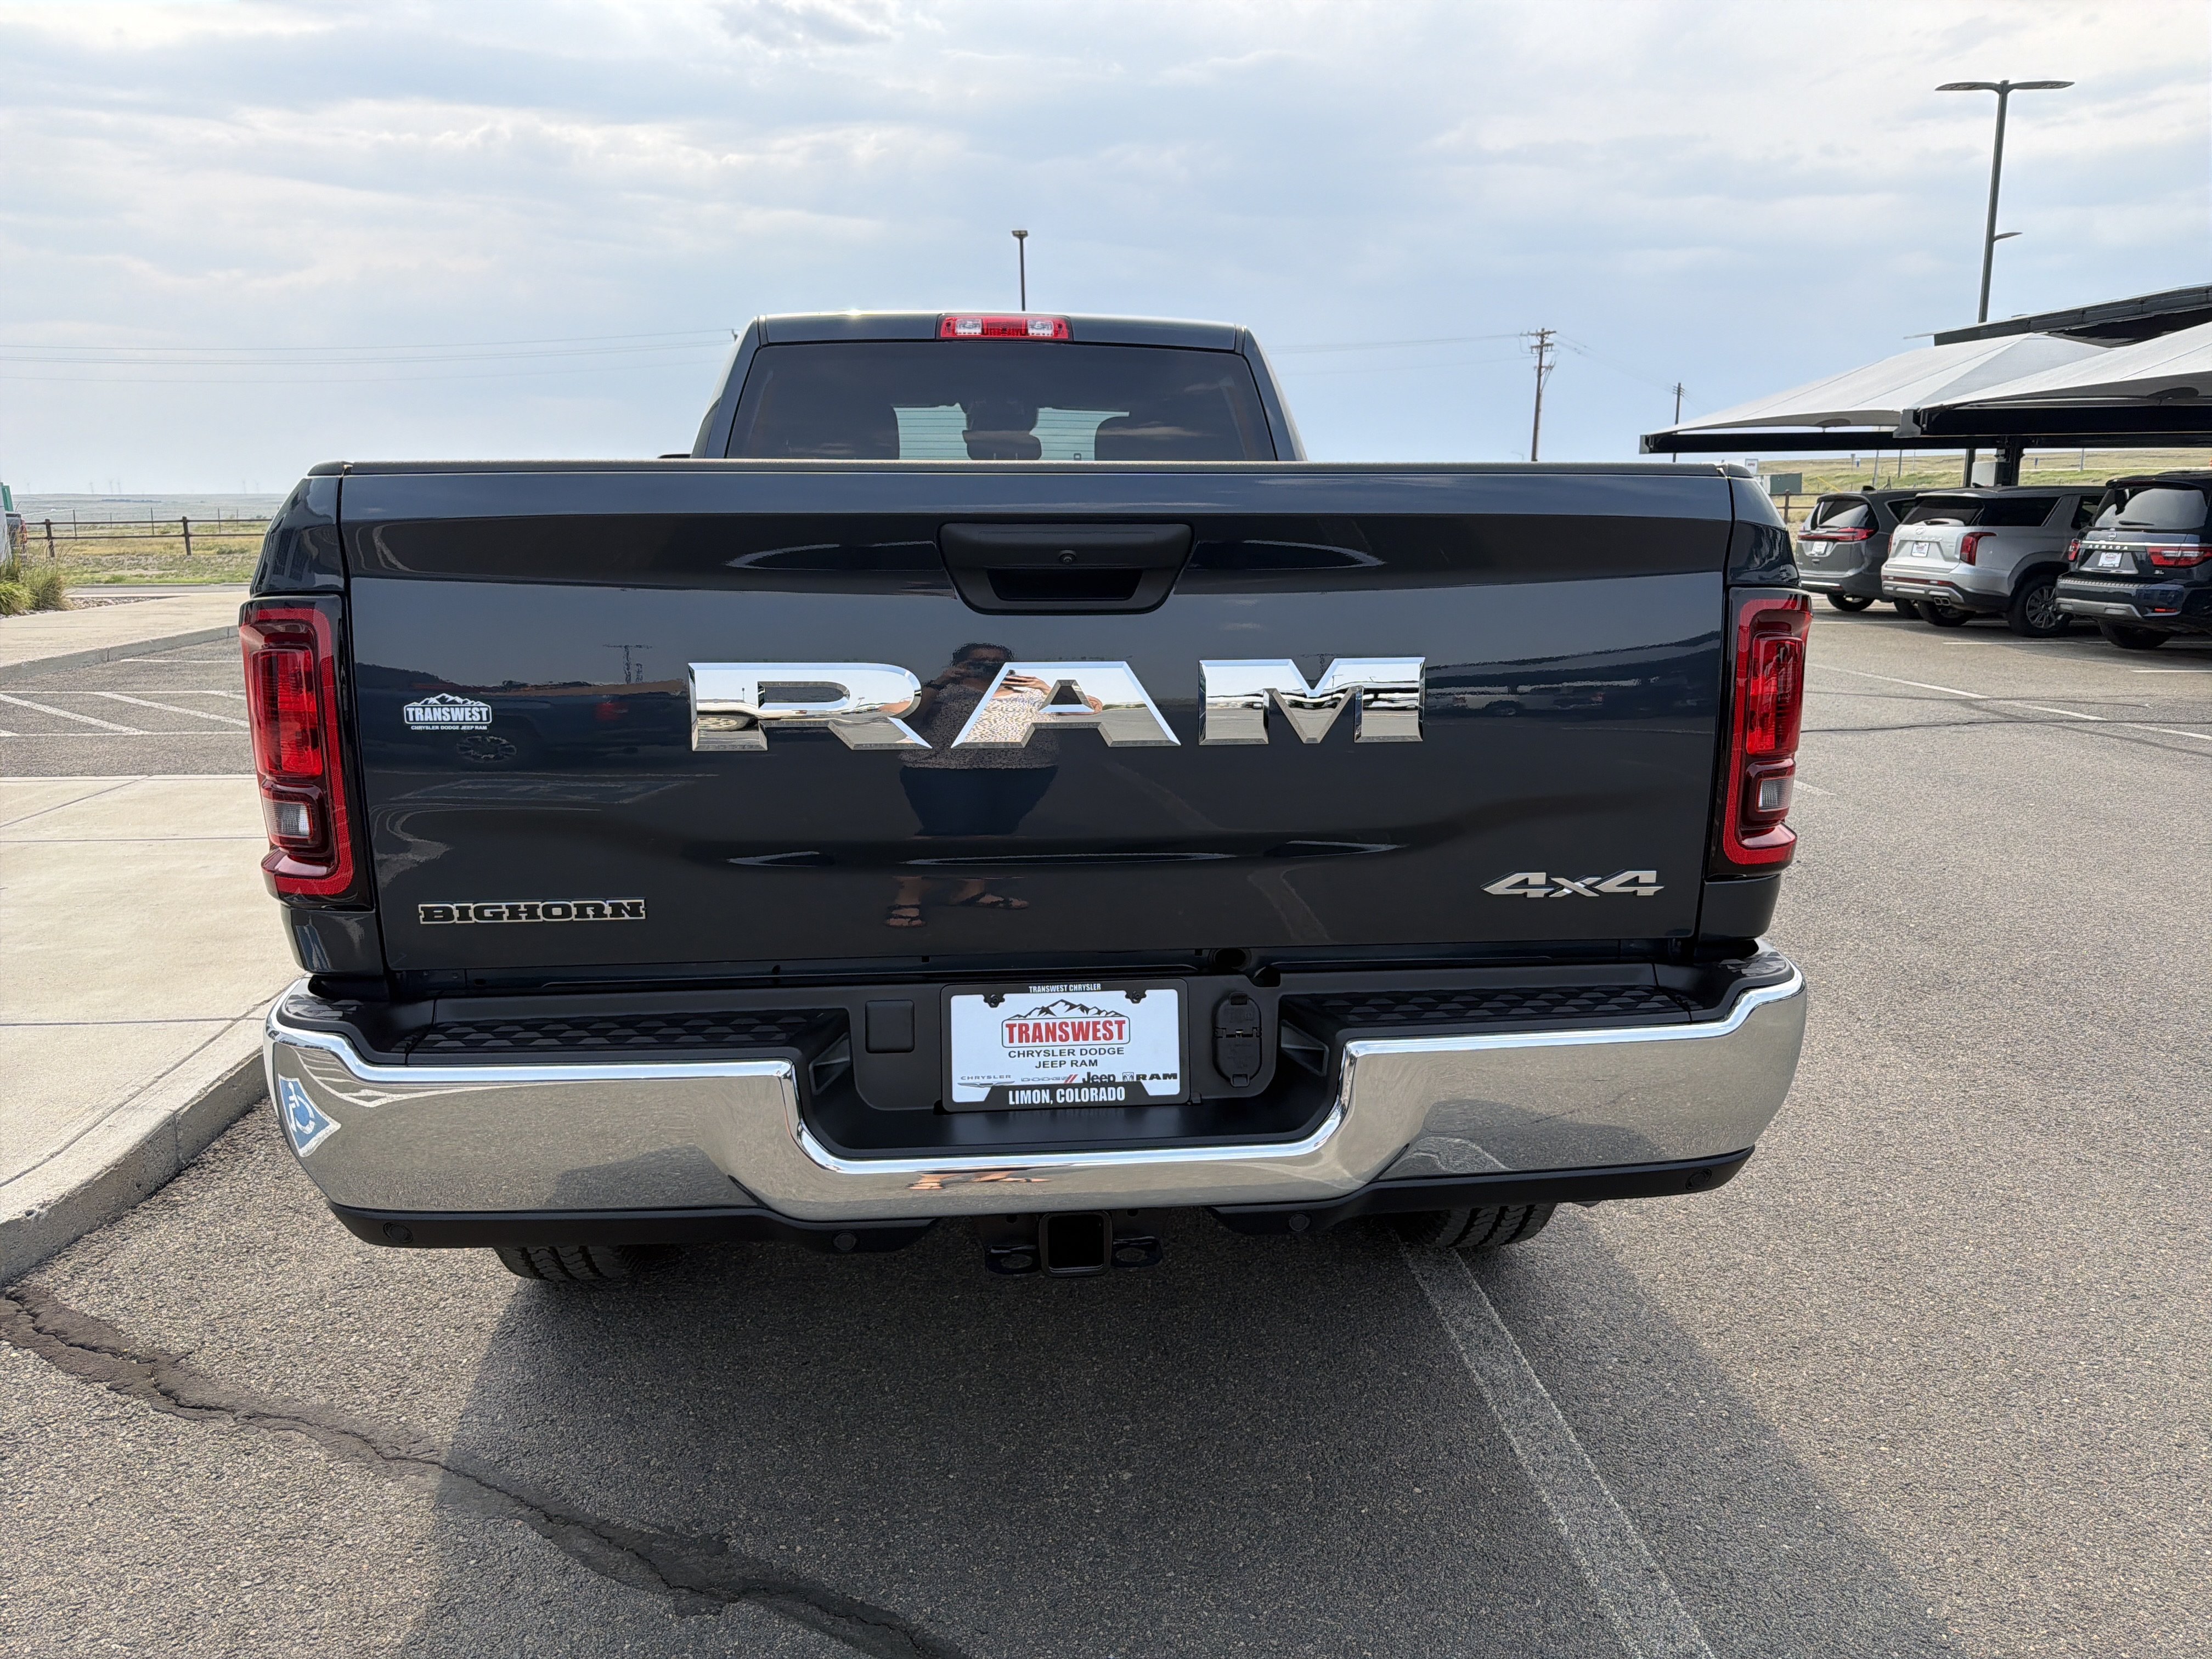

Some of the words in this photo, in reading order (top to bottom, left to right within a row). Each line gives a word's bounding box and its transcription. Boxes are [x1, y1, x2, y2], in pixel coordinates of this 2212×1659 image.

[688, 657, 1425, 752] RAM
[406, 707, 488, 721] TRANSWEST
[418, 897, 646, 924] BIGHORN
[1029, 984, 1068, 993] TRANSWEST
[1069, 983, 1101, 991] CHRYSLER
[1005, 1019, 1126, 1044] TRANSWEST
[1008, 1048, 1076, 1058] CHRYSLER
[1080, 1047, 1125, 1056] DODGE
[1035, 1060, 1066, 1069] JEEP
[1070, 1059, 1098, 1068] RAM
[1082, 1071, 1116, 1084] Jeep
[1136, 1073, 1178, 1081] RAM
[1008, 1089, 1053, 1105] LIMON,
[1056, 1086, 1125, 1103] COLORADO
